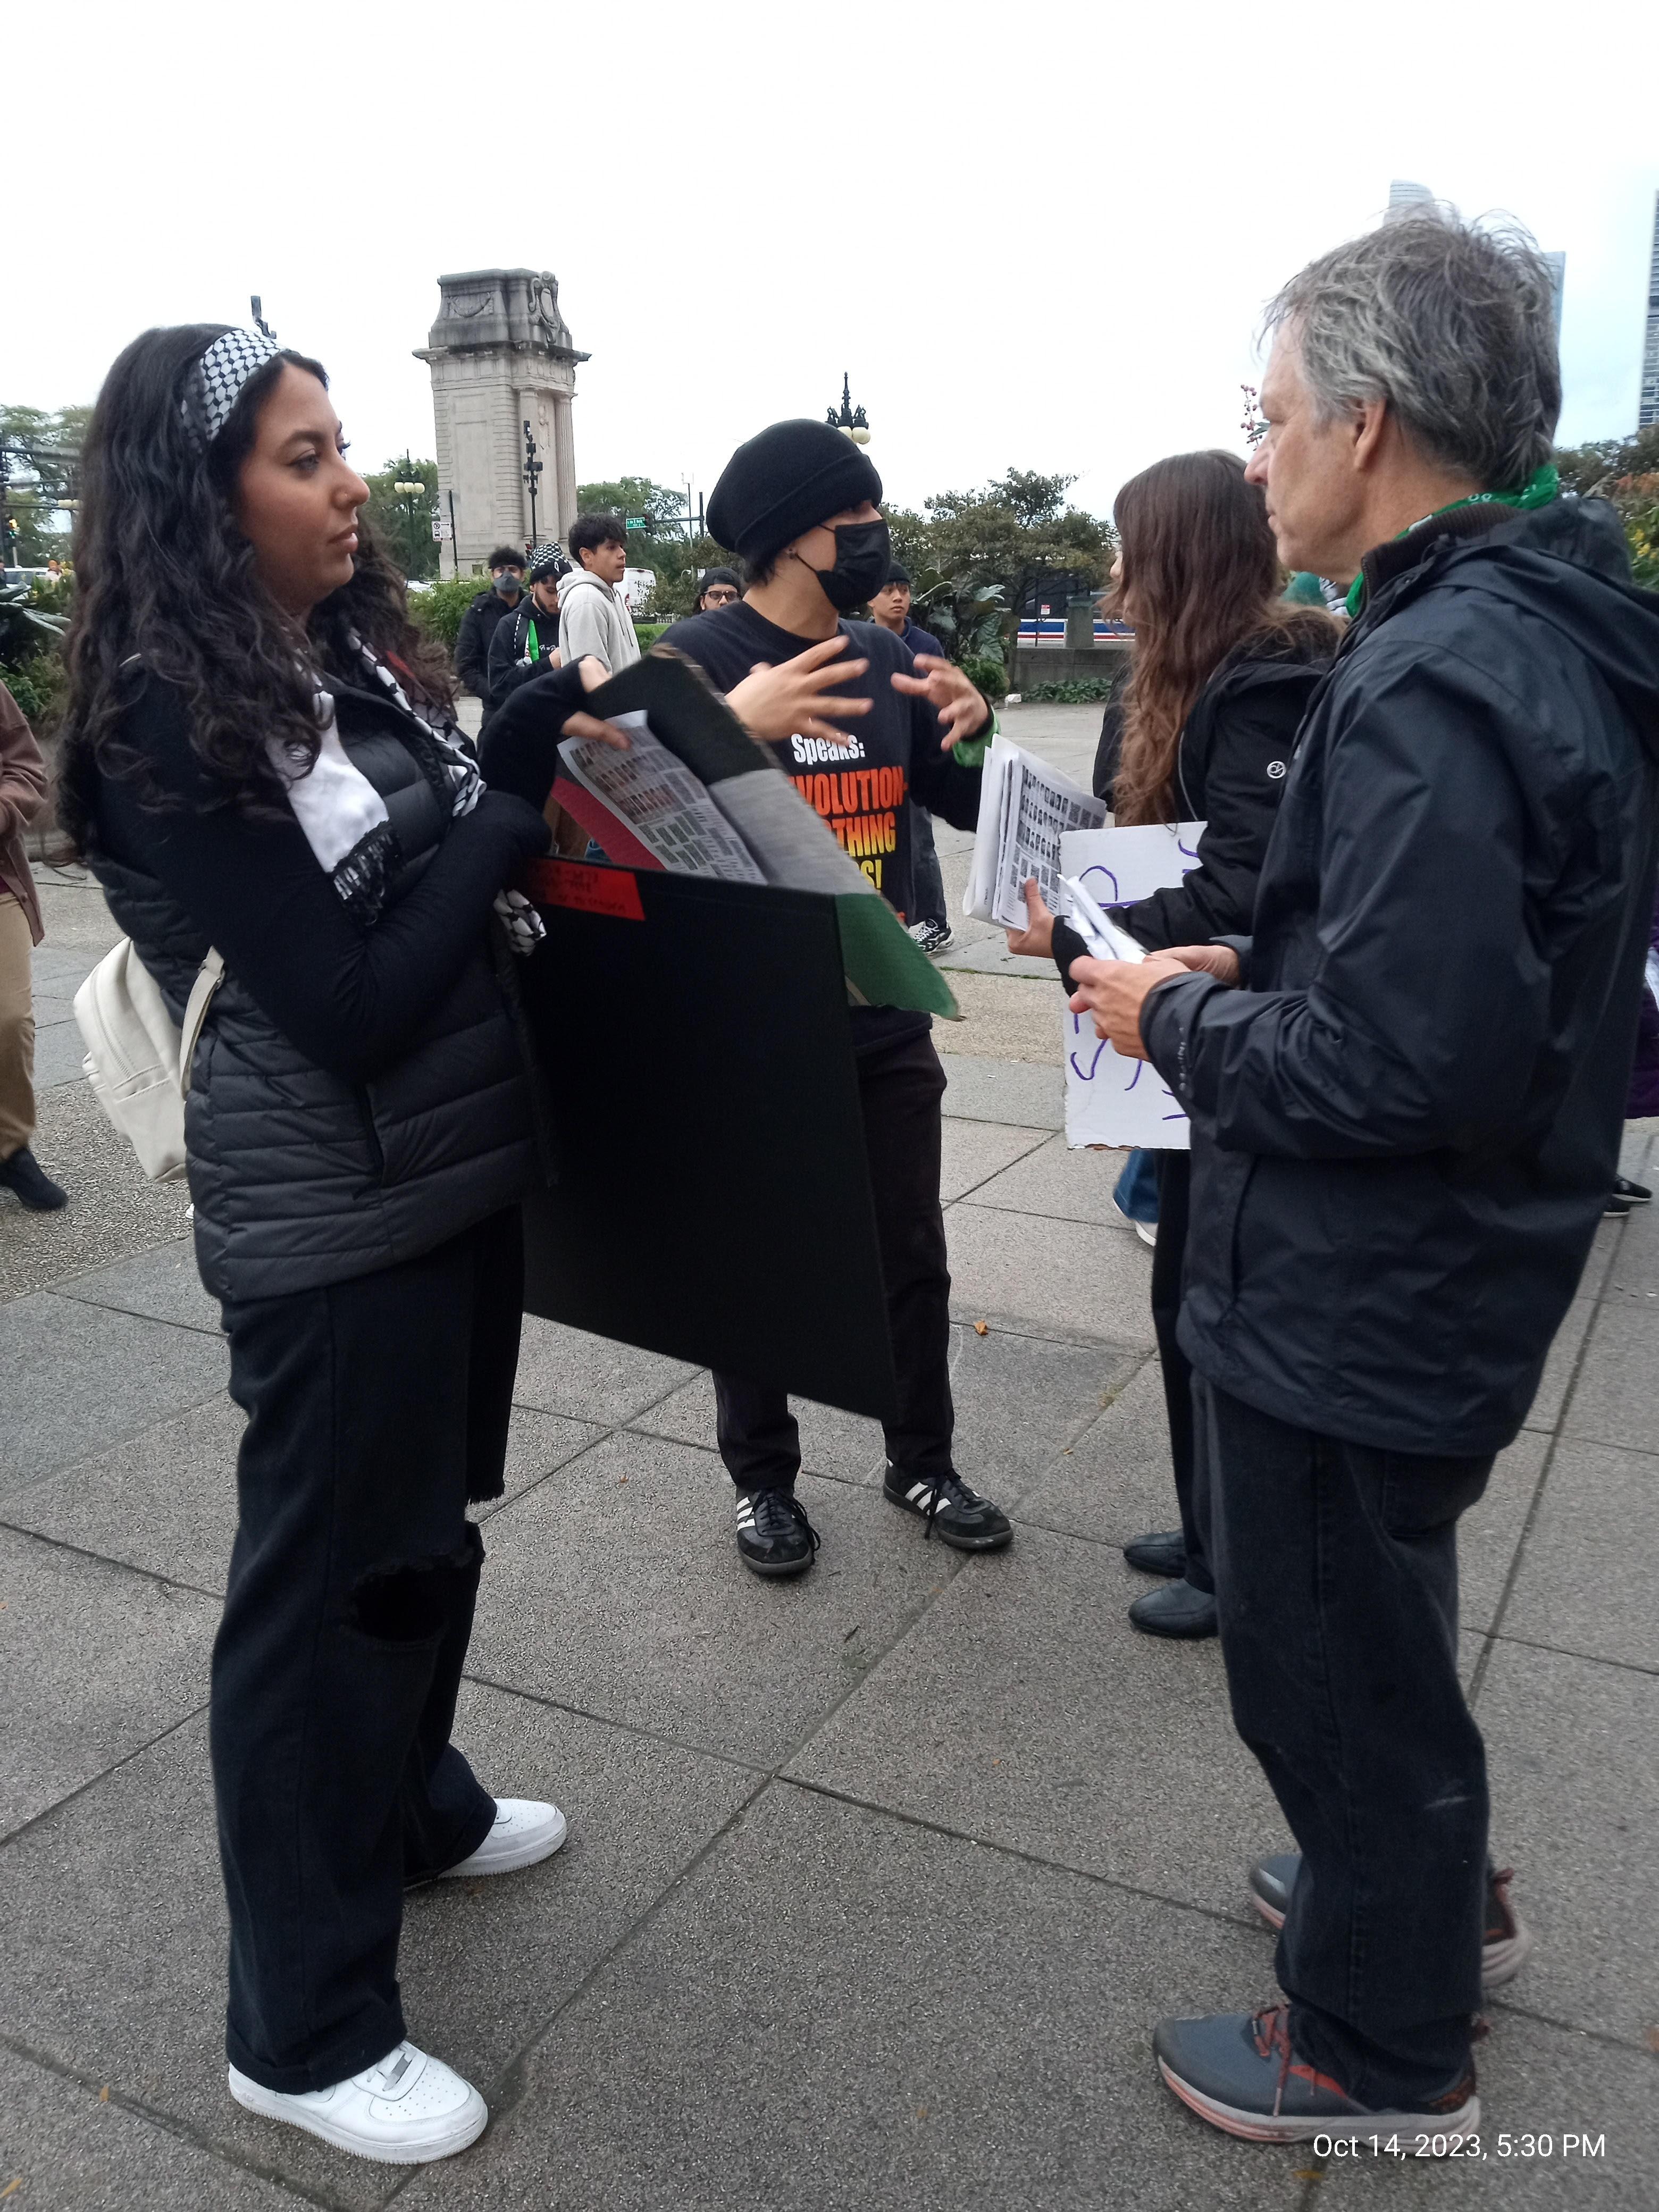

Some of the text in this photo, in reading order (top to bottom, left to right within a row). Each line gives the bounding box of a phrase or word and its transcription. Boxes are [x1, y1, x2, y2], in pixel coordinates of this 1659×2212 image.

[791, 733, 866, 765] Speaks:
[787, 765, 909, 816] VOLUTION-
[822, 811, 896, 857] THING
